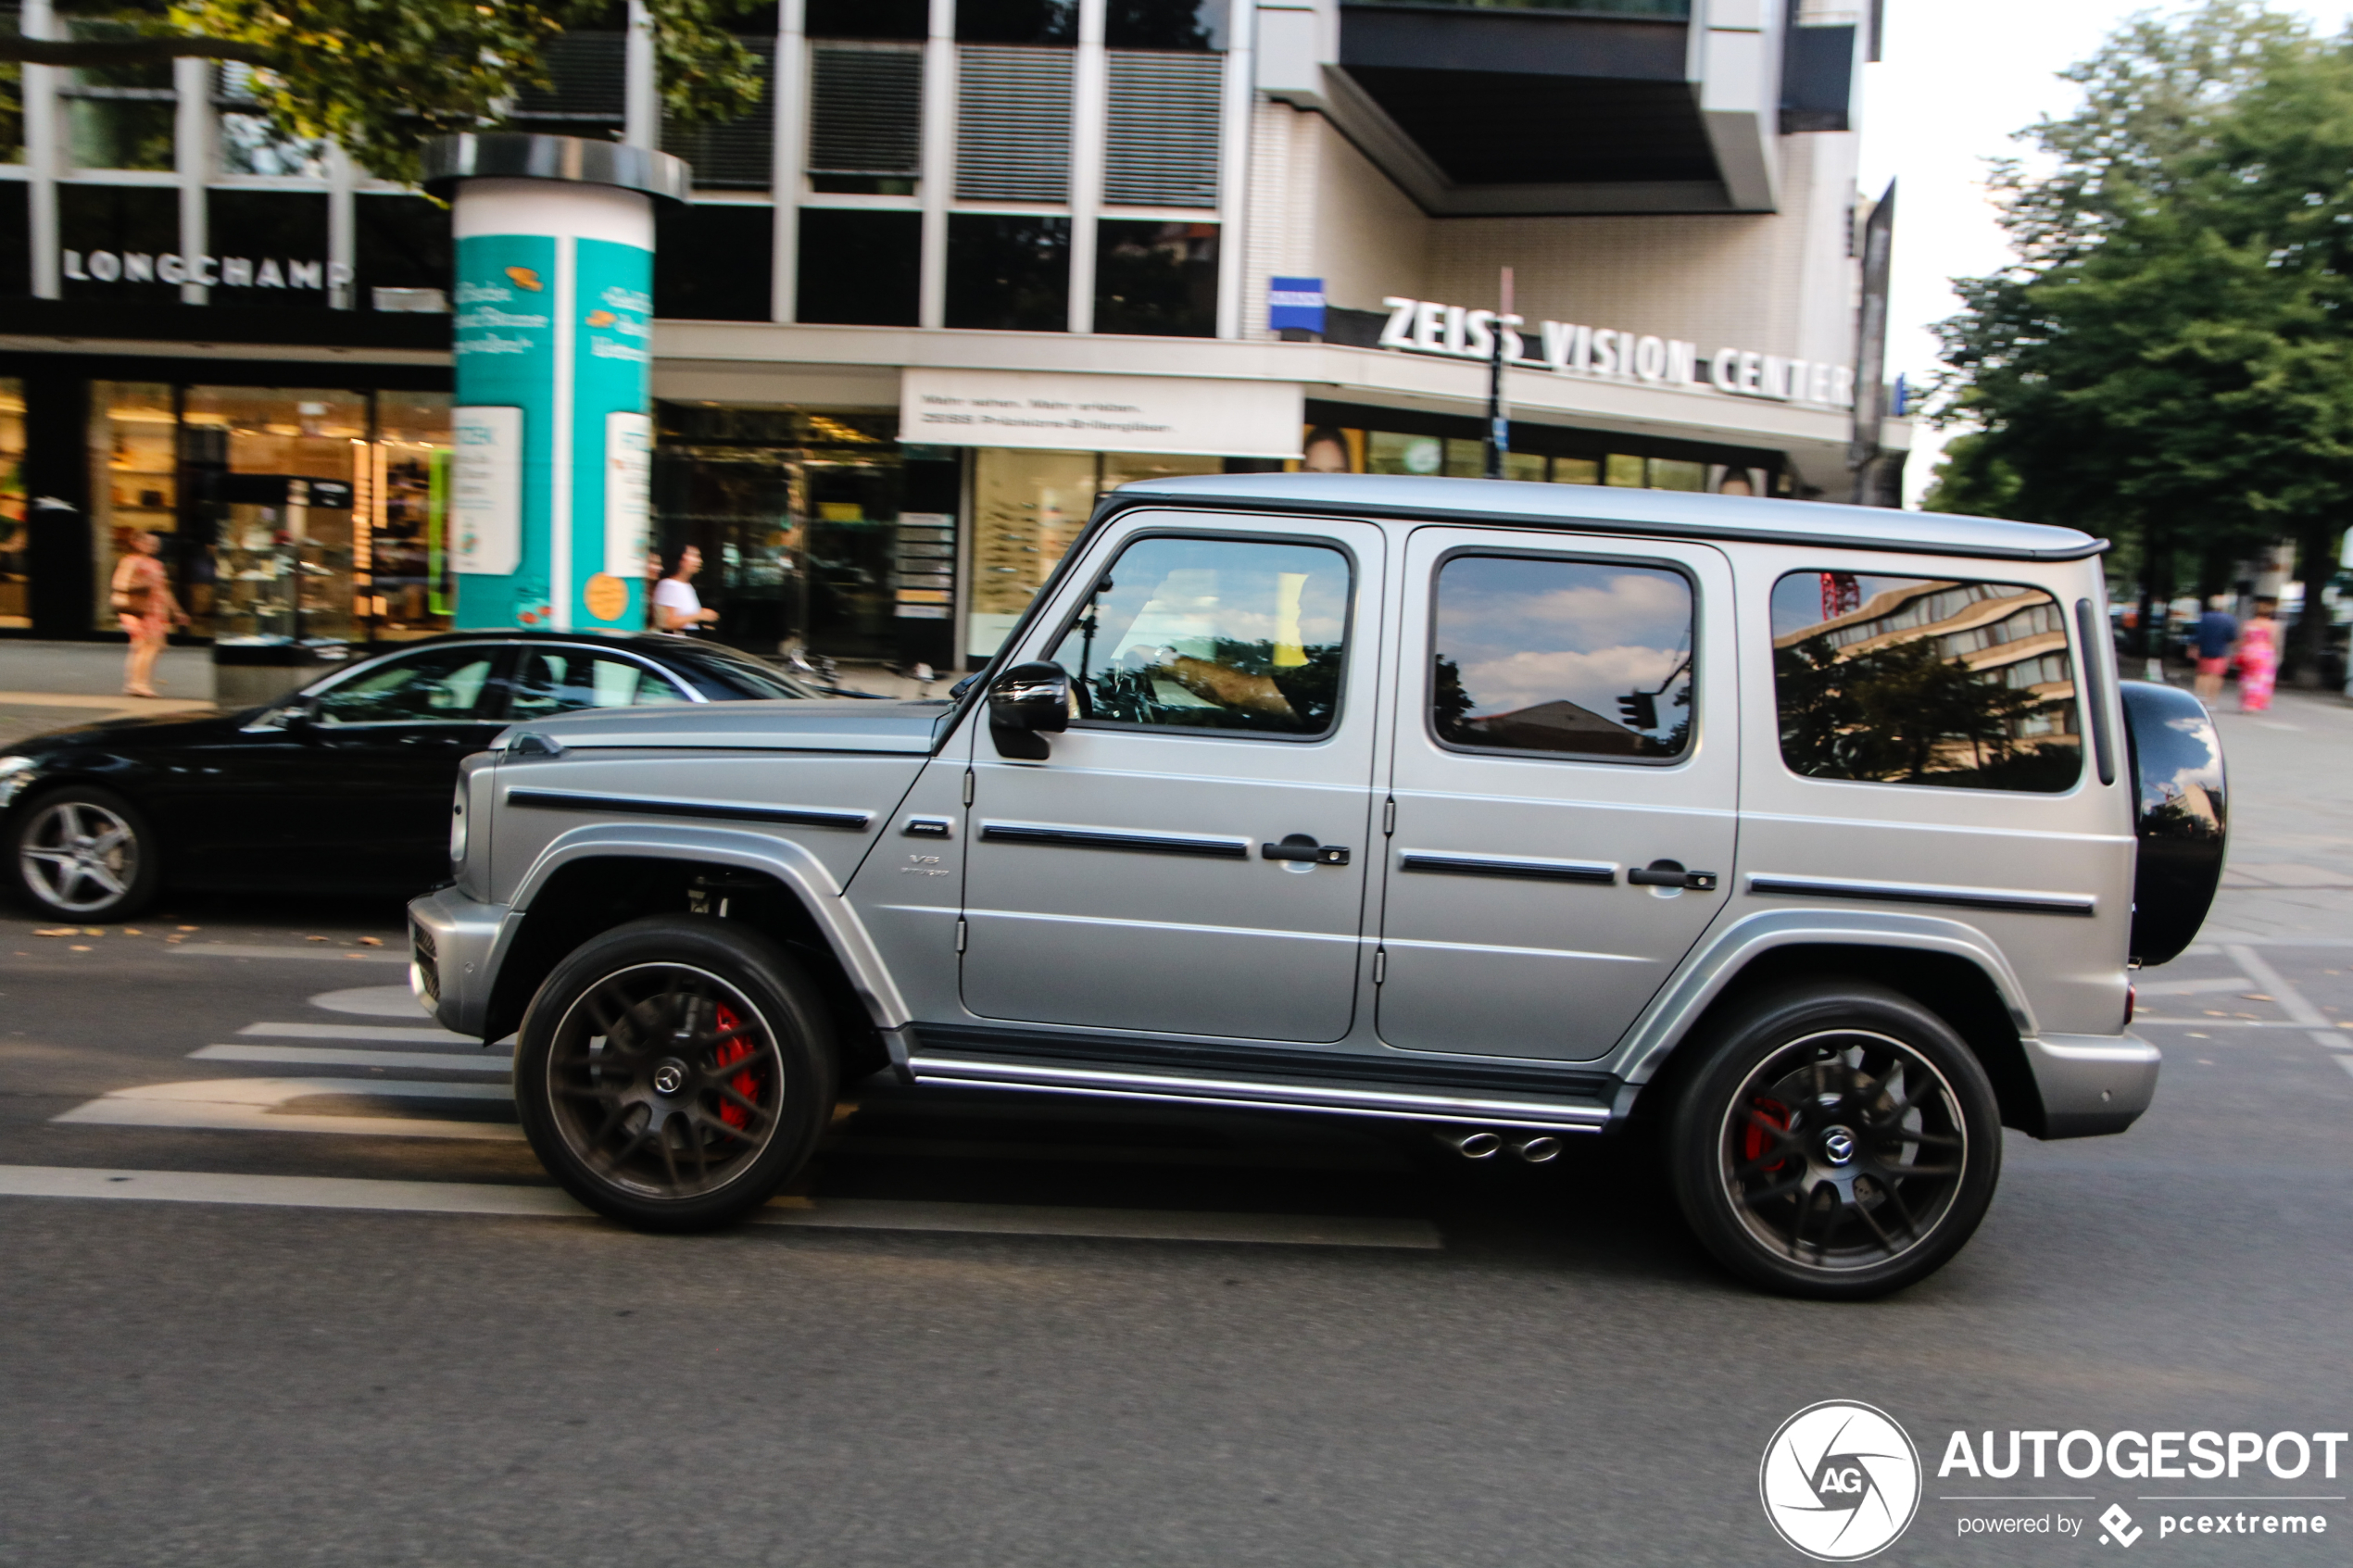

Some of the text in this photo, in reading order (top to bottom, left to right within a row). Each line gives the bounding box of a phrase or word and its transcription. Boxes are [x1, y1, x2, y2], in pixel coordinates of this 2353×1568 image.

[61, 248, 356, 291] LONGCHAMP
[1378, 295, 1853, 406] ZEISS VISION CENTER
[909, 854, 940, 865] V8
